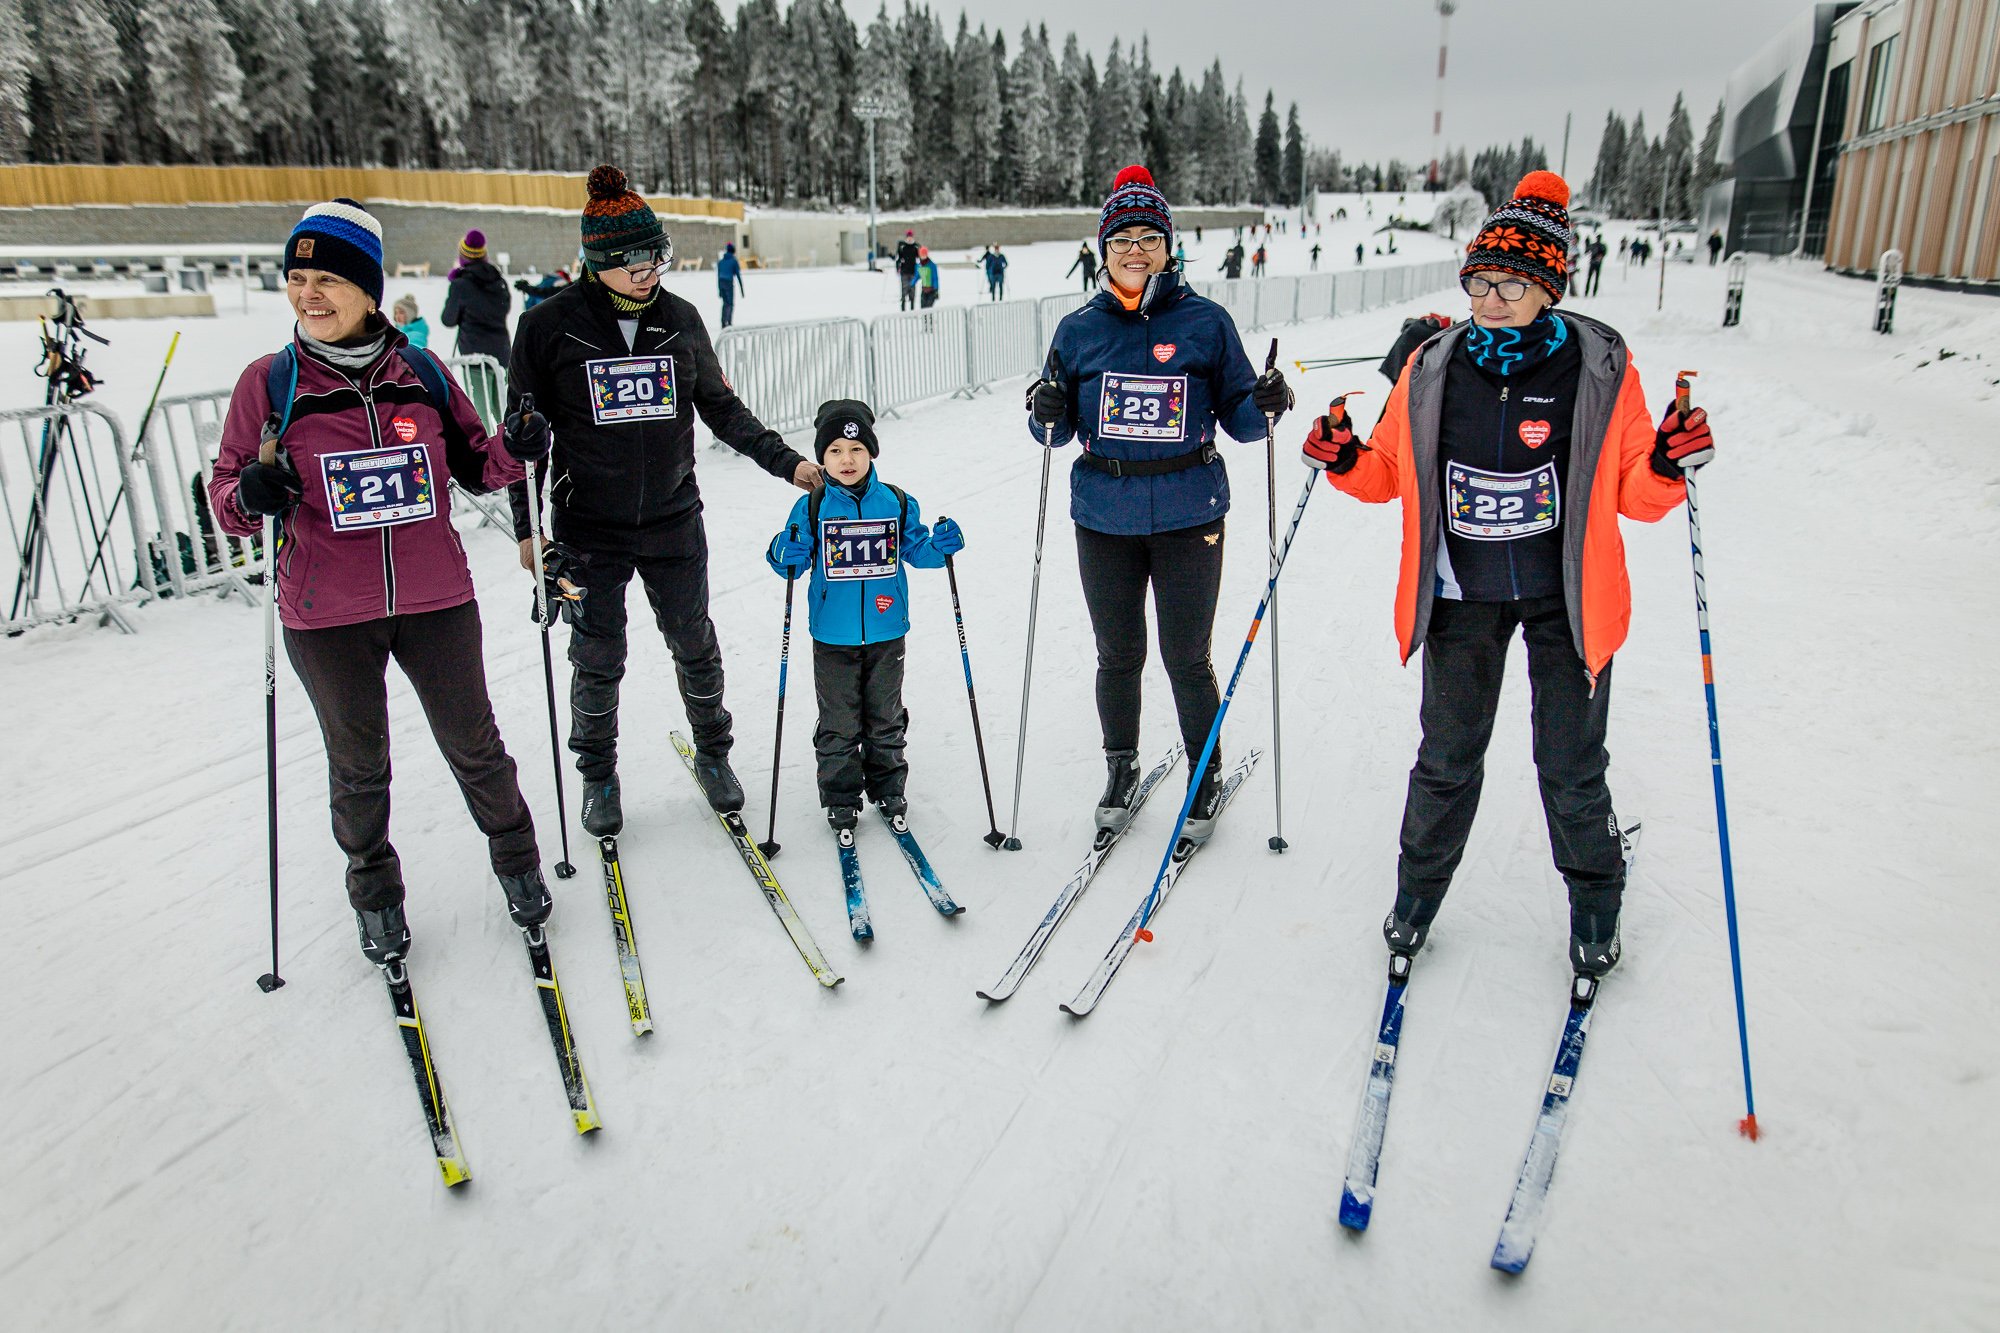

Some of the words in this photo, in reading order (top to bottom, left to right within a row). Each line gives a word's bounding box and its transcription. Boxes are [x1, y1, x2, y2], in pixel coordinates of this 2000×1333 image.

[616, 377, 654, 402] 20
[1123, 396, 1160, 421] 23
[360, 472, 405, 504] 21
[1474, 494, 1524, 520] 22
[838, 538, 887, 562] 111
[626, 983, 642, 1021] FISCHER
